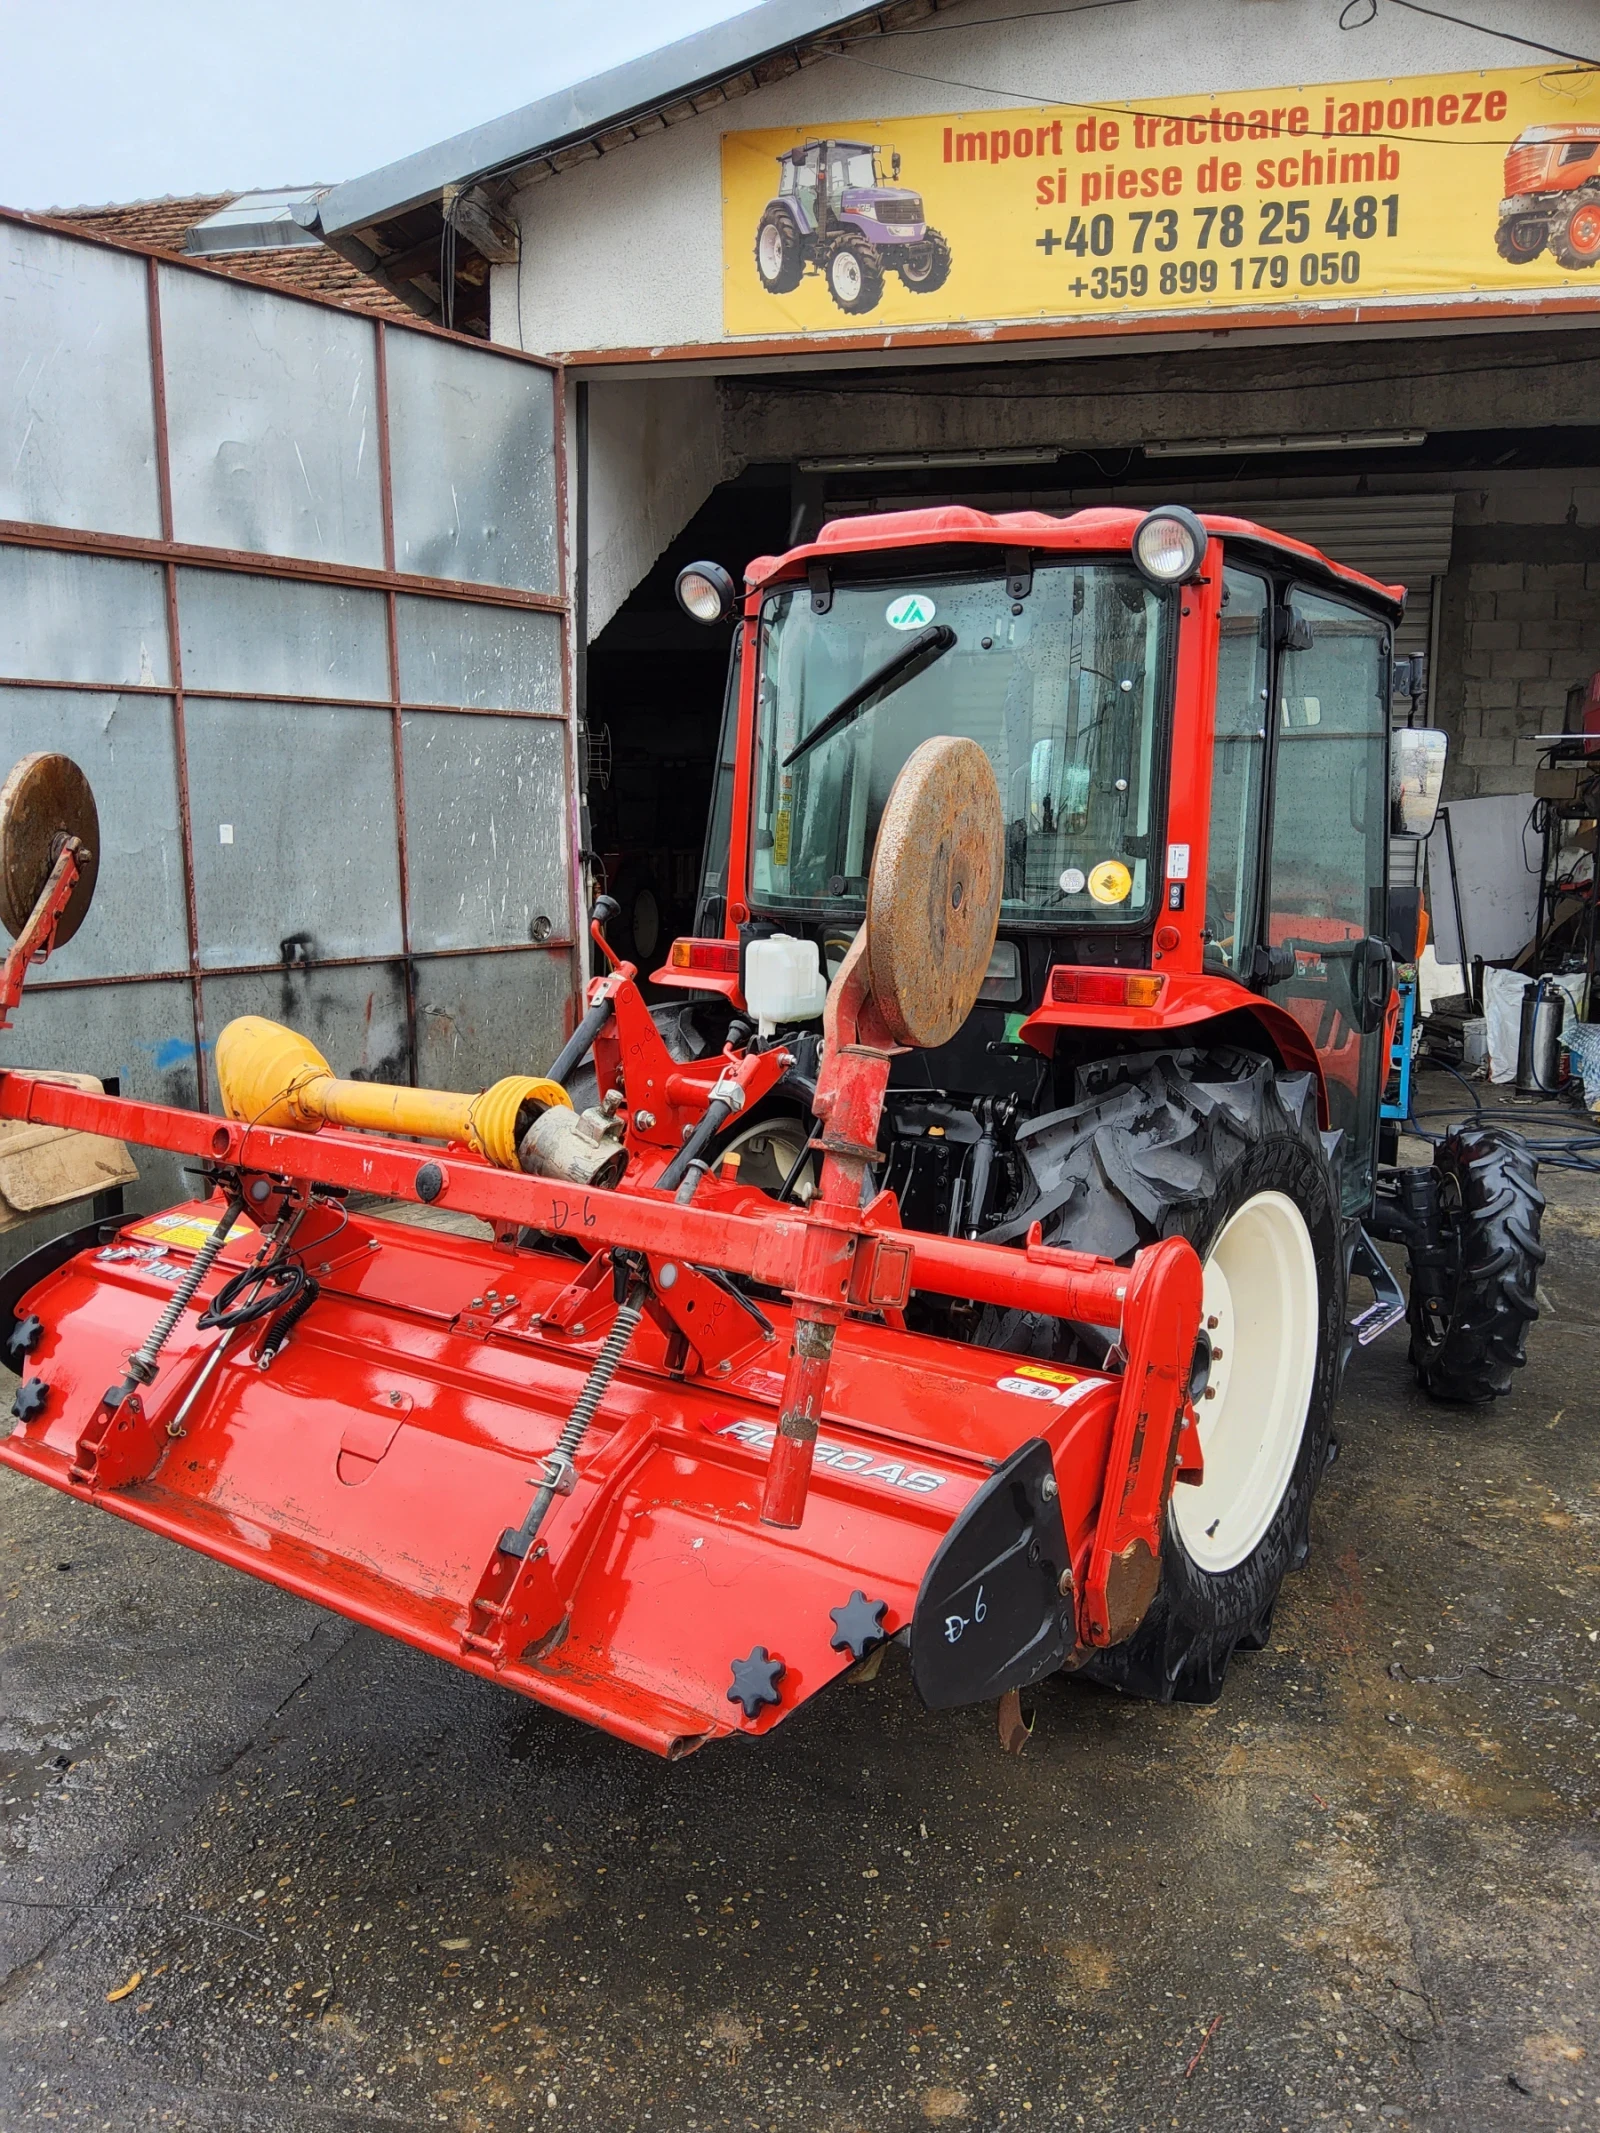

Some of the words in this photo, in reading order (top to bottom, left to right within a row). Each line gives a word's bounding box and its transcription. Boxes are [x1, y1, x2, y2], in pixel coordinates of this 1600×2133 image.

[943, 120, 1063, 164] Import
[1076, 116, 1120, 153] de
[1133, 105, 1309, 149] tractoare
[1322, 90, 1508, 138] japoneze
[1036, 168, 1067, 204] si
[1081, 164, 1183, 206] piese
[1197, 156, 1242, 194] de
[1255, 144, 1400, 189] schimb
[1035, 213, 1114, 257] +40
[1128, 209, 1179, 254] 73
[1193, 204, 1244, 250] 78
[1258, 200, 1310, 246] 25
[1325, 194, 1399, 240] 481
[1068, 264, 1148, 299] +359
[1159, 259, 1218, 295] 899
[1230, 255, 1289, 290] 179
[1300, 250, 1360, 286] 050
